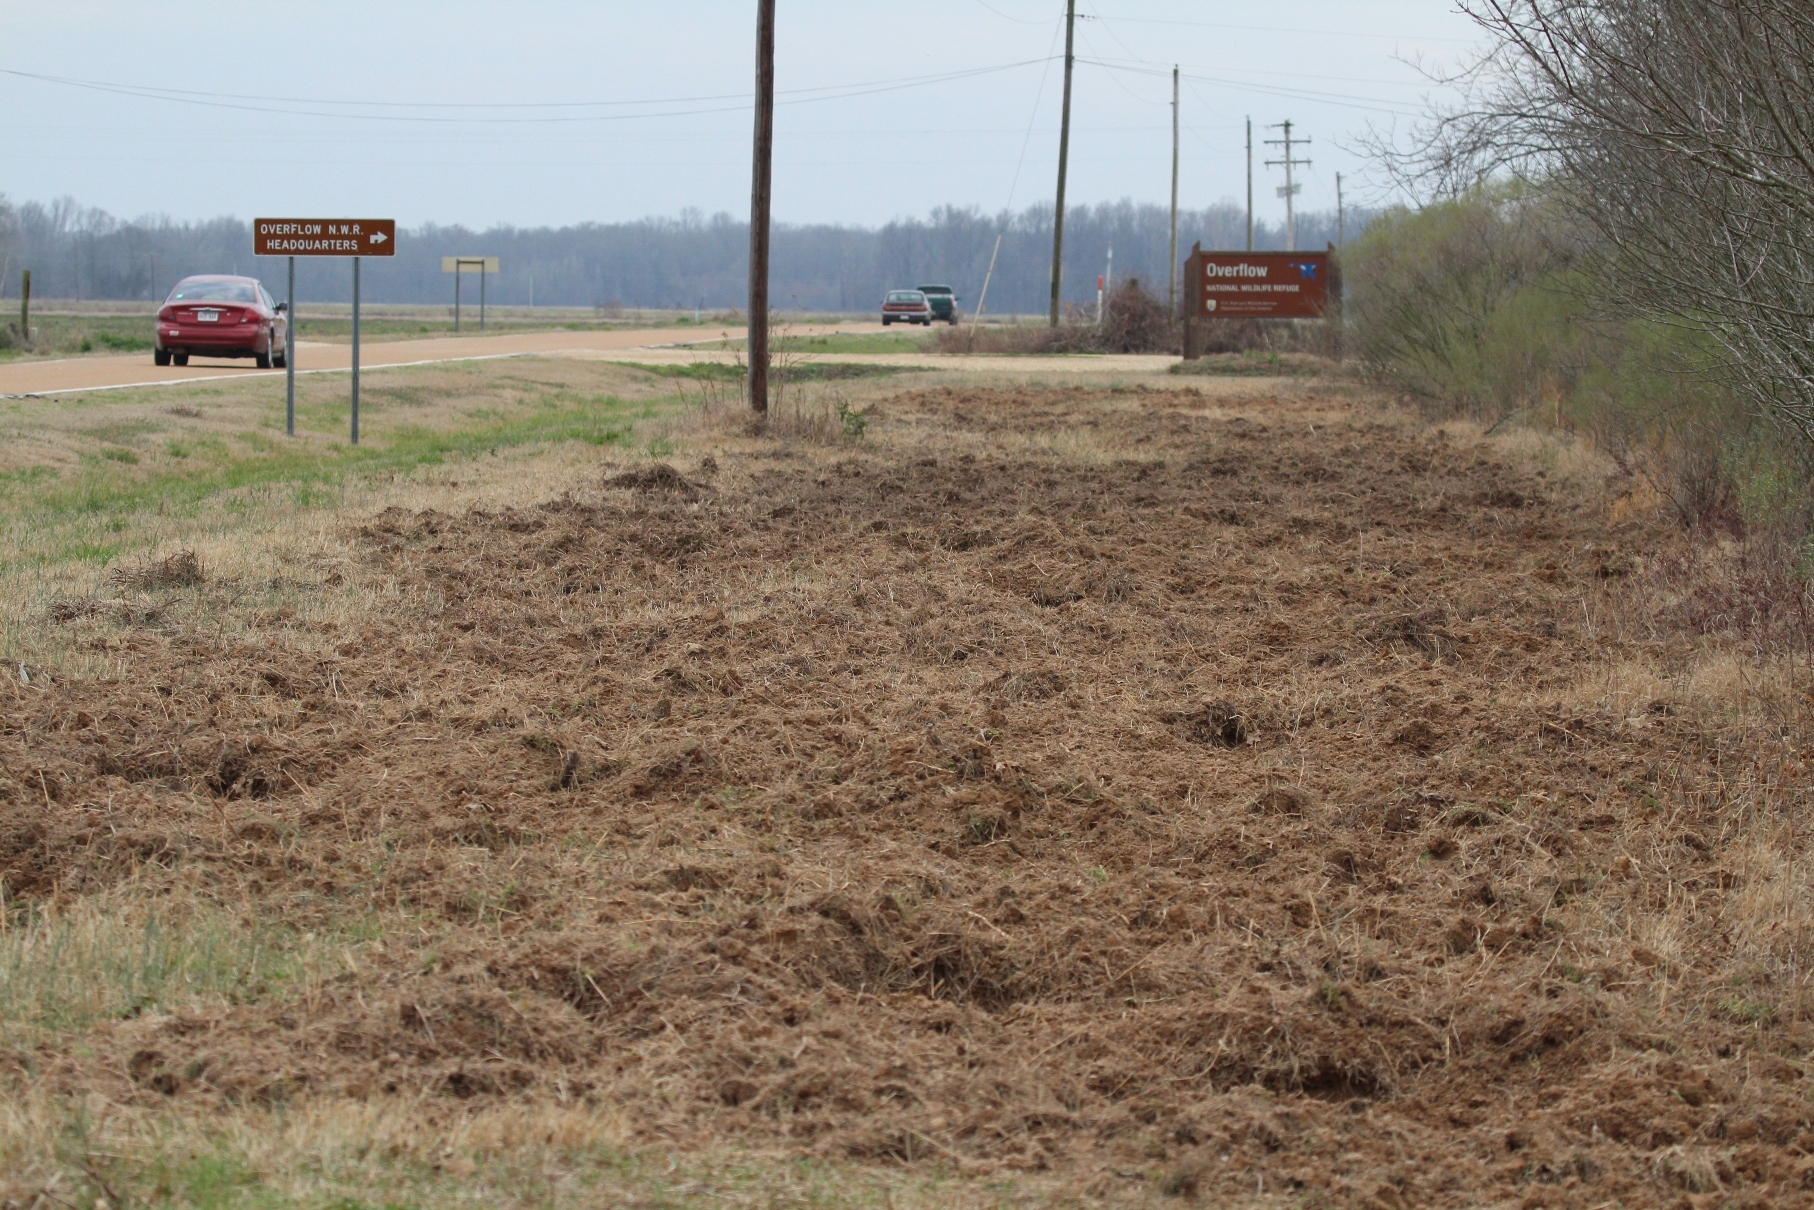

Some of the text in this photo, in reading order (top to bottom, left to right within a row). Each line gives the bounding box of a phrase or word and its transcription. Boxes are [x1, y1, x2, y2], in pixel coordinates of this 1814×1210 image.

[260, 223, 364, 235] OVERFLOW N.W.R.
[266, 239, 358, 250] HEADQUARTERS
[1206, 262, 1268, 277] Overflow
[1206, 284, 1300, 292] NATIONAL WILDLIFE REFUGE
